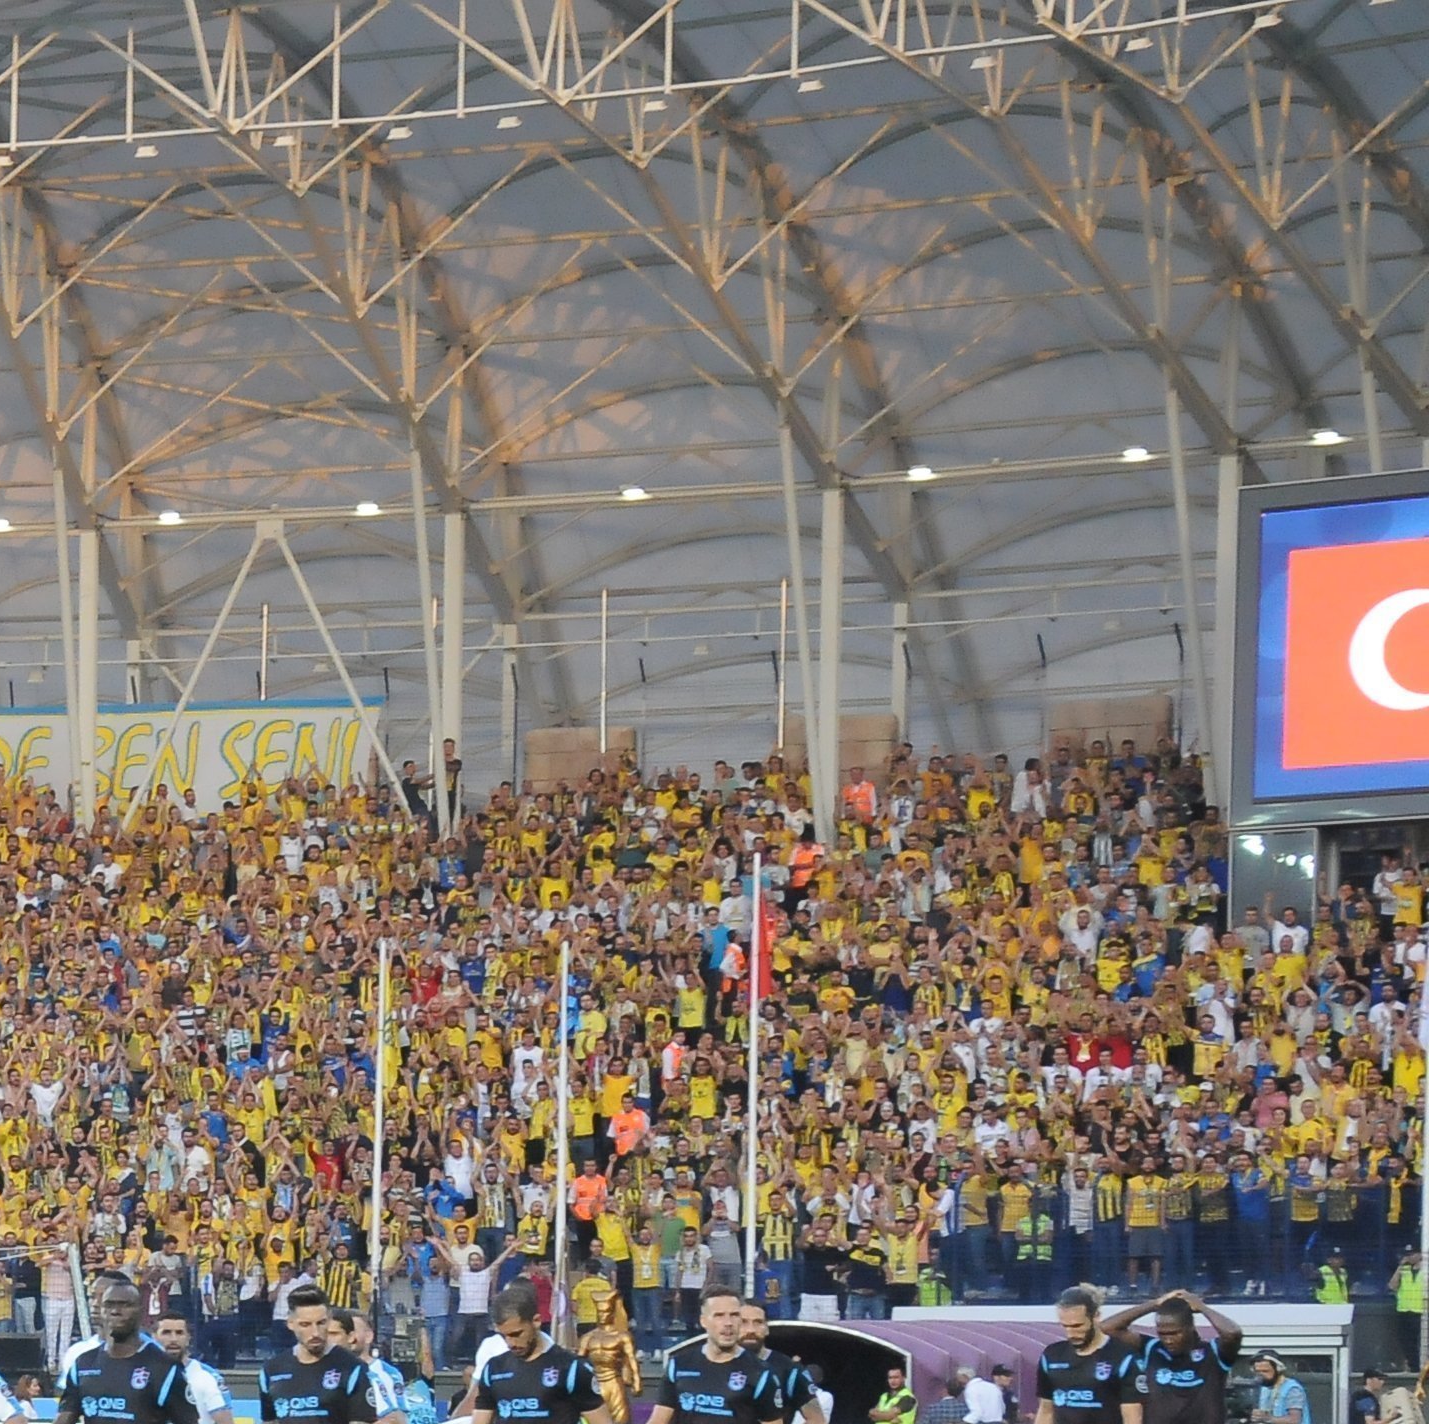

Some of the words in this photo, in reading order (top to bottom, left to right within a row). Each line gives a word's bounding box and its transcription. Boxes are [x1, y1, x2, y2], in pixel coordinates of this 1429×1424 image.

[695, 1394, 725, 1408] QNB
[1067, 1390, 1094, 1401] QNB
[98, 1397, 126, 1411] QNB
[291, 1396, 319, 1408] QNB
[512, 1398, 539, 1410] QNB
